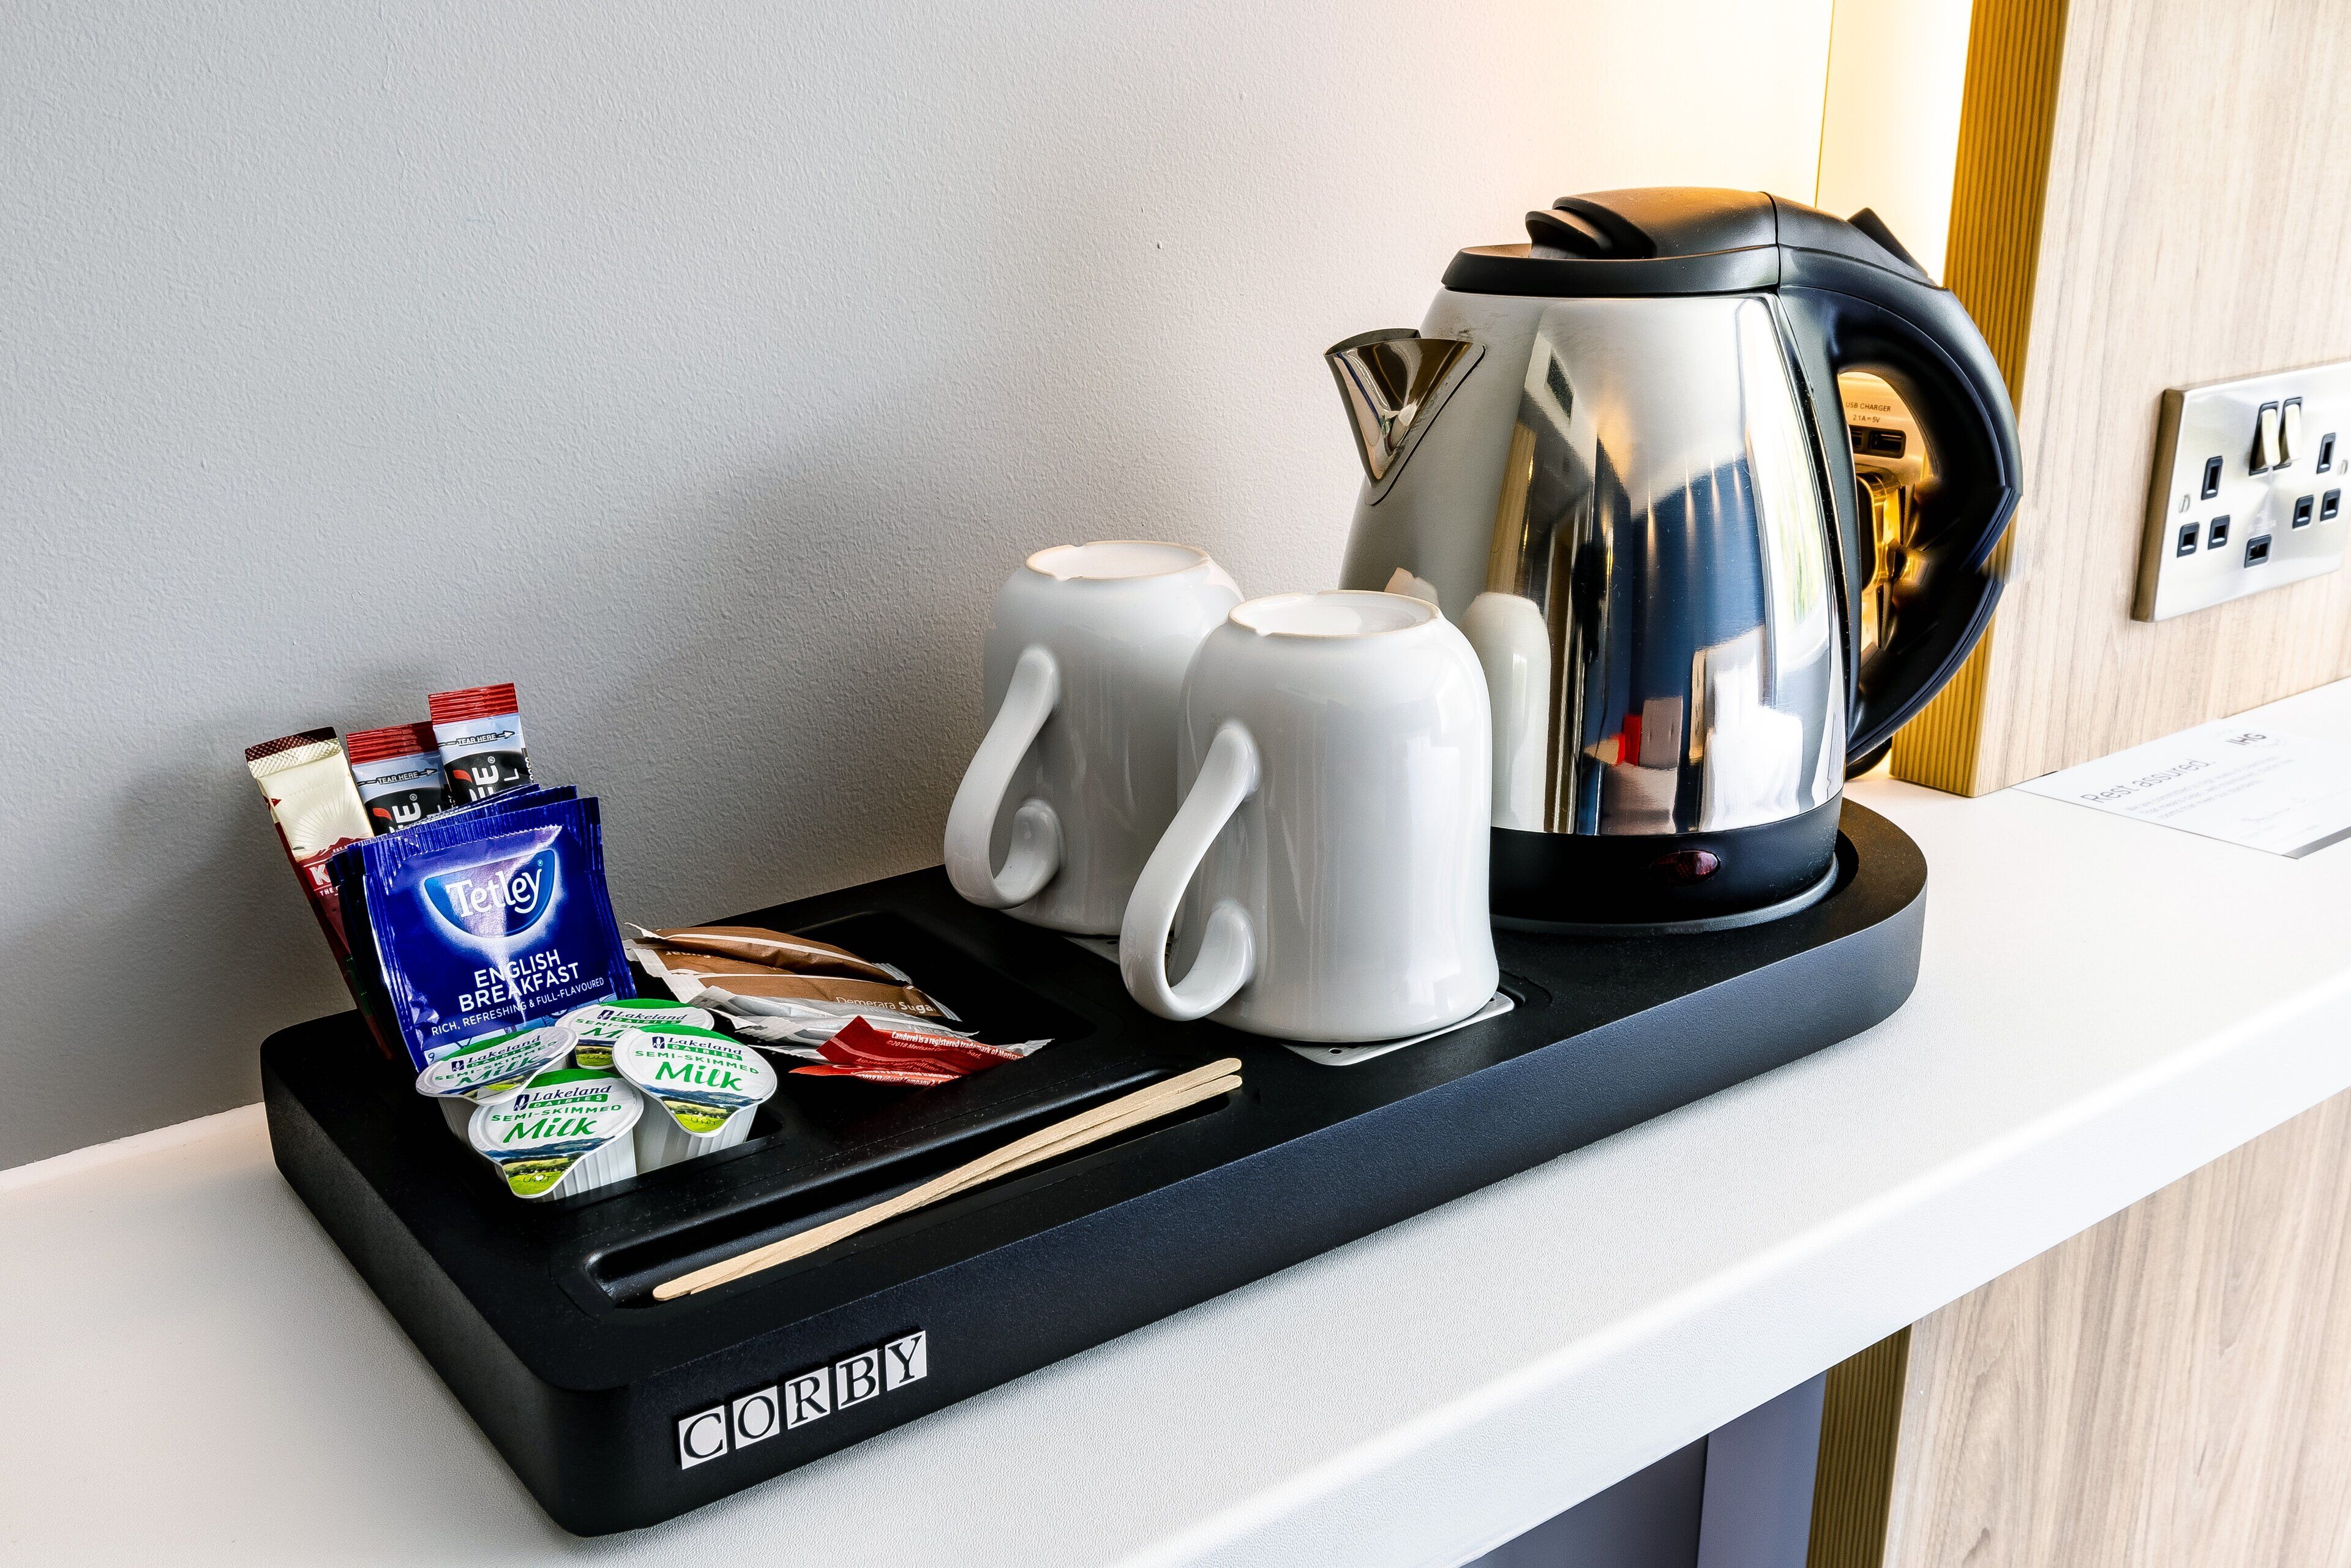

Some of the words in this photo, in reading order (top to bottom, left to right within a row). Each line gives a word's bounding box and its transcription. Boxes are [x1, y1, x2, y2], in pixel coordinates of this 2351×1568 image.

[1860, 403, 1891, 412] CHARGER
[478, 733, 497, 743] HERE
[2225, 733, 2267, 746] IHG
[378, 776, 397, 784] TEAR
[399, 771, 419, 781] HERE
[2080, 784, 2140, 803] Rest
[319, 887, 334, 896] THE
[444, 868, 542, 918] Tetley
[474, 948, 561, 989] ENGLISH
[458, 962, 579, 1013] BREAKFAST
[430, 1020, 460, 1037] RICH,
[463, 1001, 527, 1027] REFRESHING
[528, 999, 536, 1008] &
[536, 977, 605, 1006] FULL-FLAVOURED
[835, 996, 896, 1010] Demerara
[614, 1011, 688, 1021] Lakeland
[467, 1035, 541, 1063] Lakeland
[668, 1037, 743, 1056] Lakeland
[891, 1030, 918, 1043] Canderel
[918, 1035, 923, 1043] is
[929, 1037, 959, 1048] registered
[960, 1041, 990, 1054] trademark
[433, 1041, 558, 1081] SEMI-SKIMMED
[471, 1043, 538, 1067] DAIRIES
[671, 1045, 740, 1060] DAIRIES
[454, 1054, 541, 1087] Milk
[635, 1050, 760, 1075] SEMI-SKIMMED
[654, 1061, 744, 1092] Milk
[903, 1076, 930, 1086] Company
[531, 1085, 613, 1102] Lakeland
[533, 1094, 604, 1108] DAIRIES
[490, 1104, 622, 1122] SEMI-SKIMMED
[690, 1117, 718, 1125] UHT
[502, 1117, 598, 1144] Milk
[683, 1334, 923, 1459] CORBY
